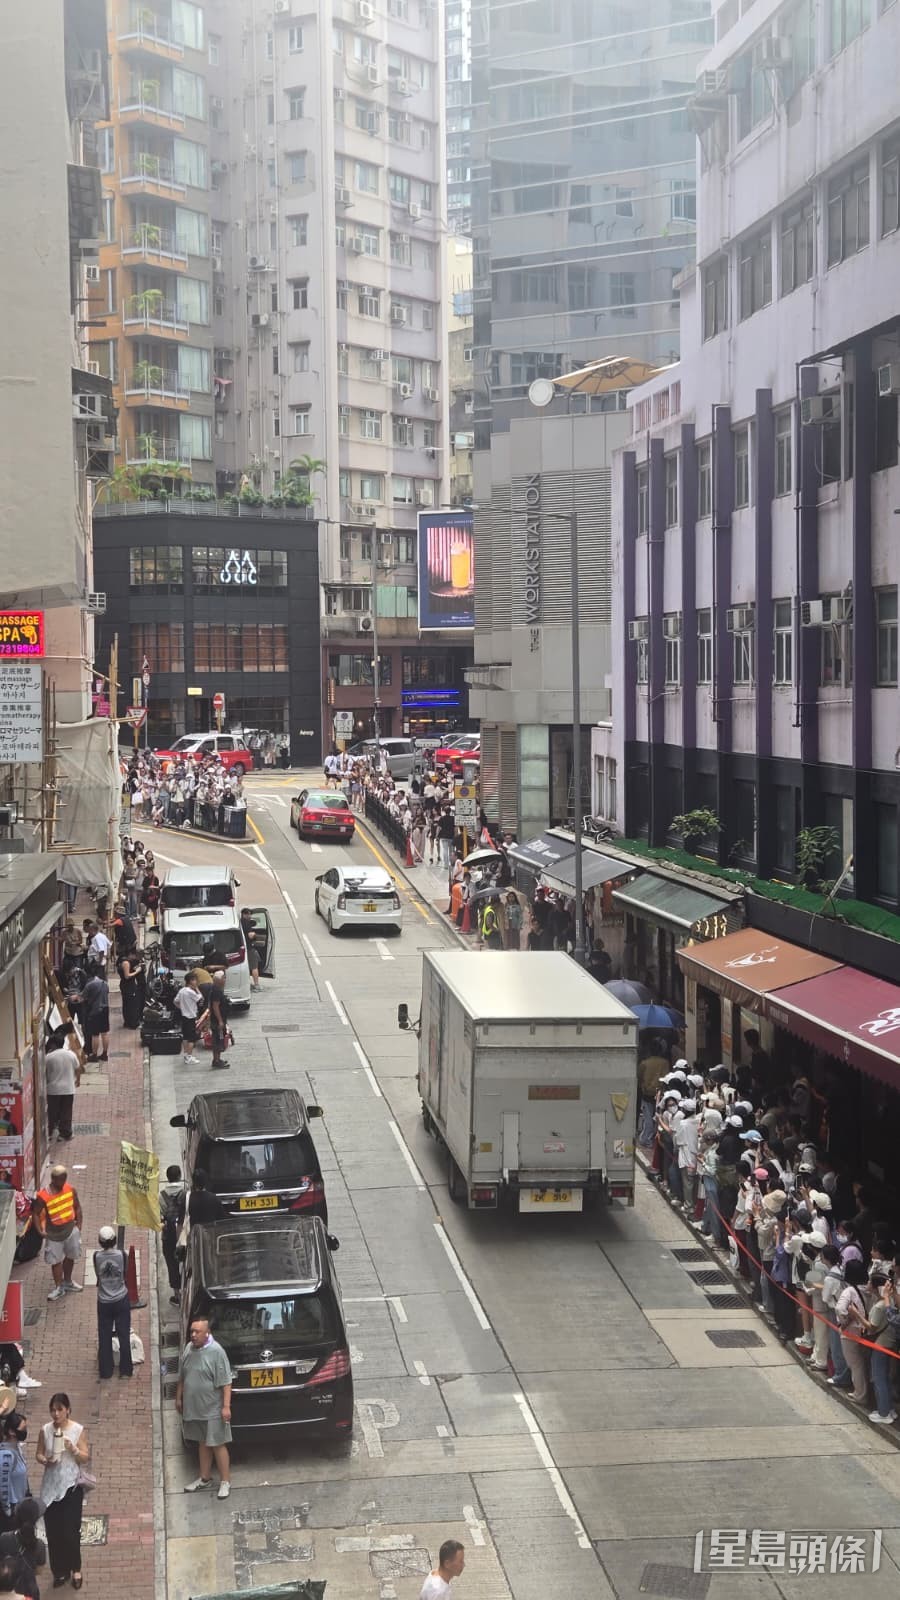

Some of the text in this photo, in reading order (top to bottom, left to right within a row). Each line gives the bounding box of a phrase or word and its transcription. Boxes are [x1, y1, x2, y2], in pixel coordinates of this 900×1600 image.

[525, 474, 540, 624] WORKSTATION
[245, 1197, 274, 1208] XH 331
[253, 1376, 280, 1386] 7731
